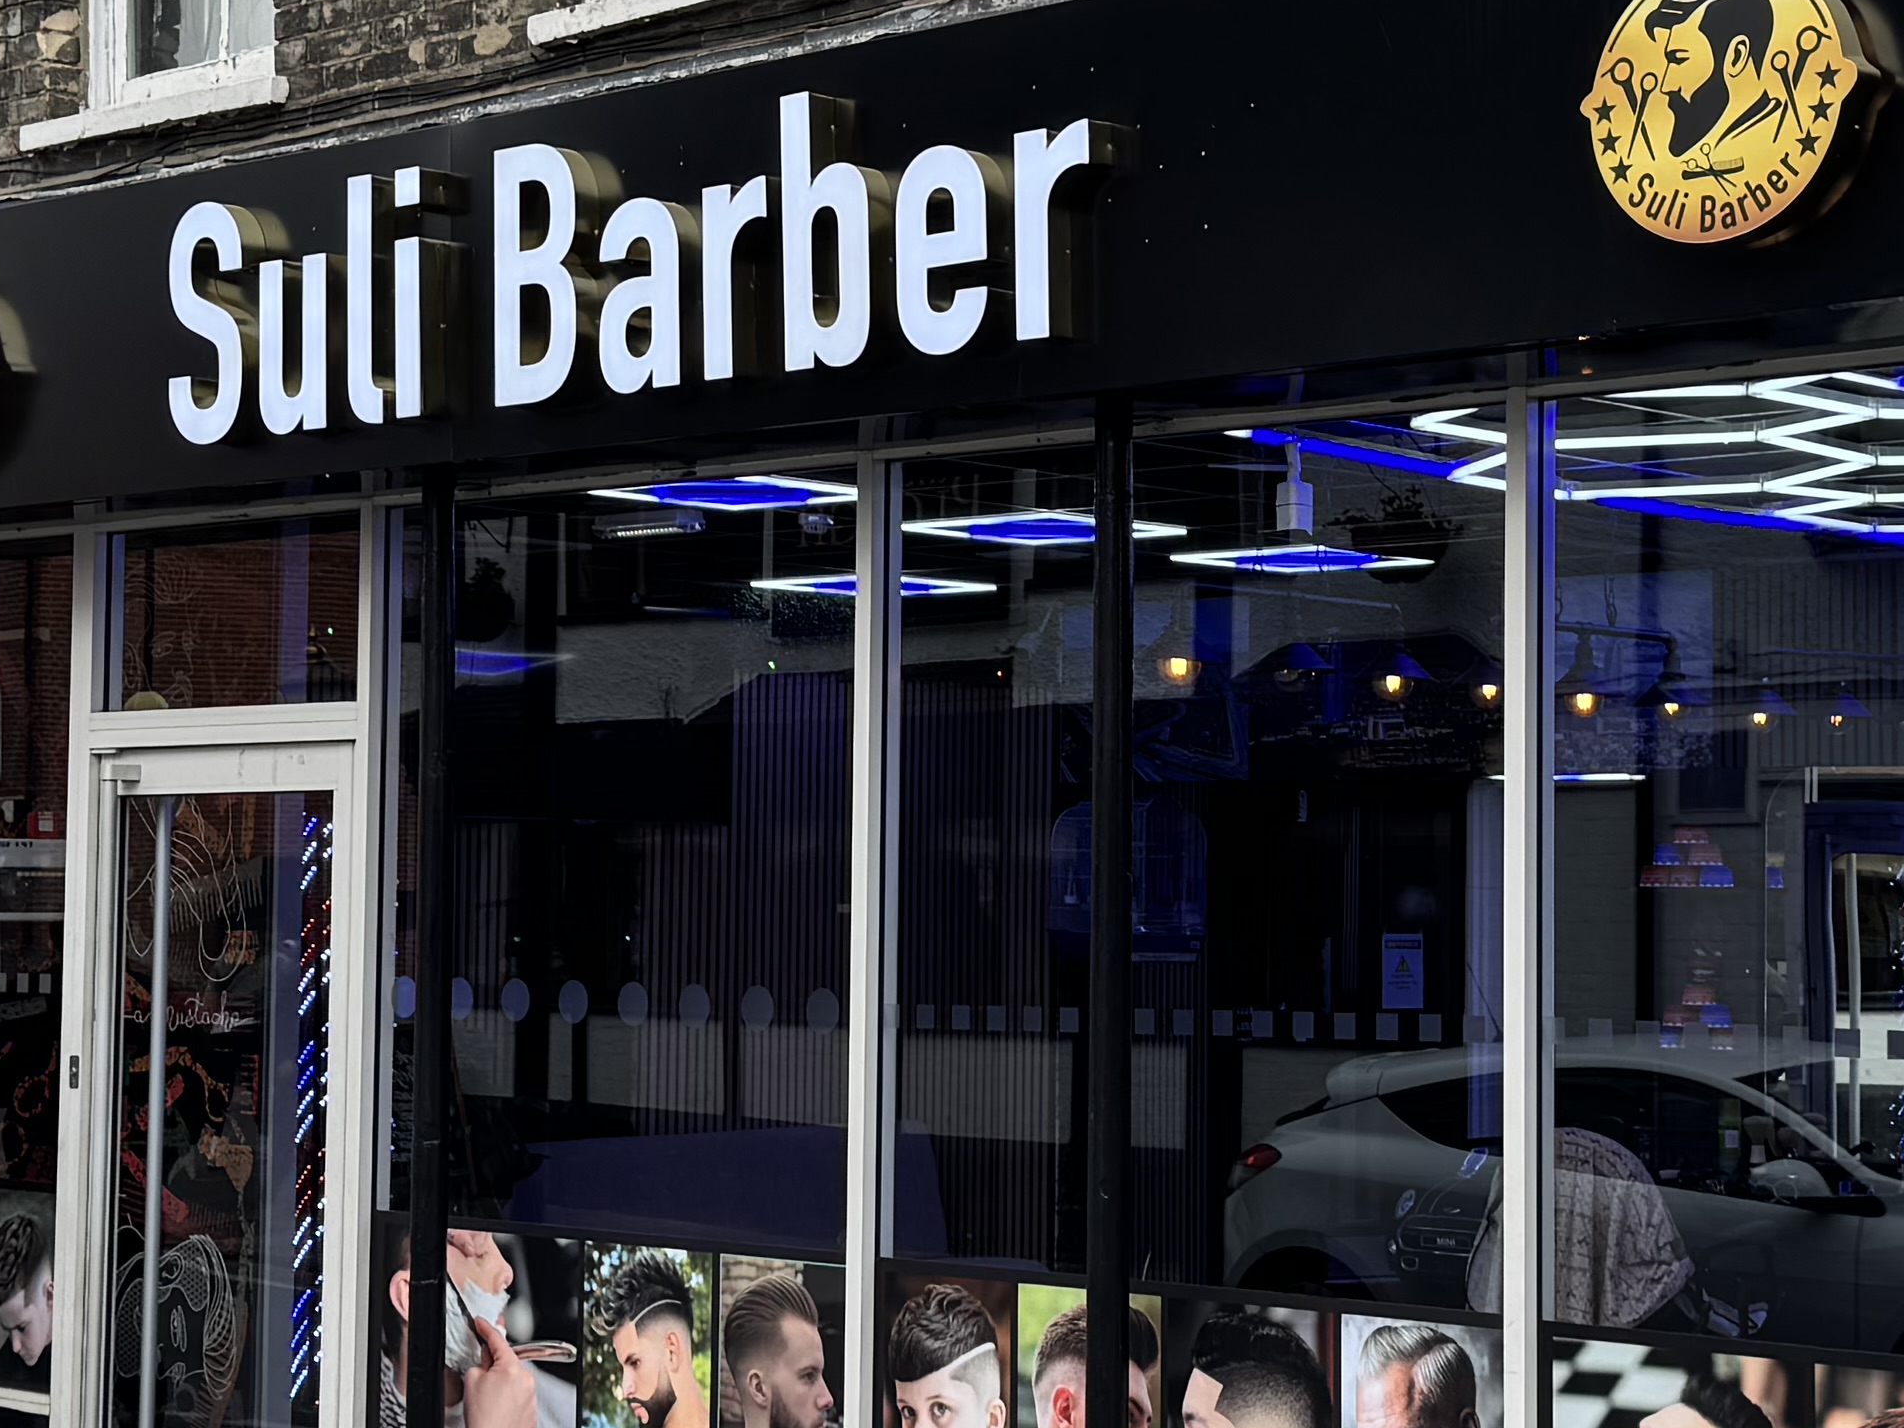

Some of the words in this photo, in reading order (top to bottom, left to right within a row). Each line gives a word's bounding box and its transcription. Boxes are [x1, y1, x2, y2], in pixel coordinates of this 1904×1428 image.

[168, 165, 421, 446] Suli
[493, 90, 1091, 407] Barber
[1628, 172, 1689, 230] Suli
[1699, 151, 1800, 233] Barber
